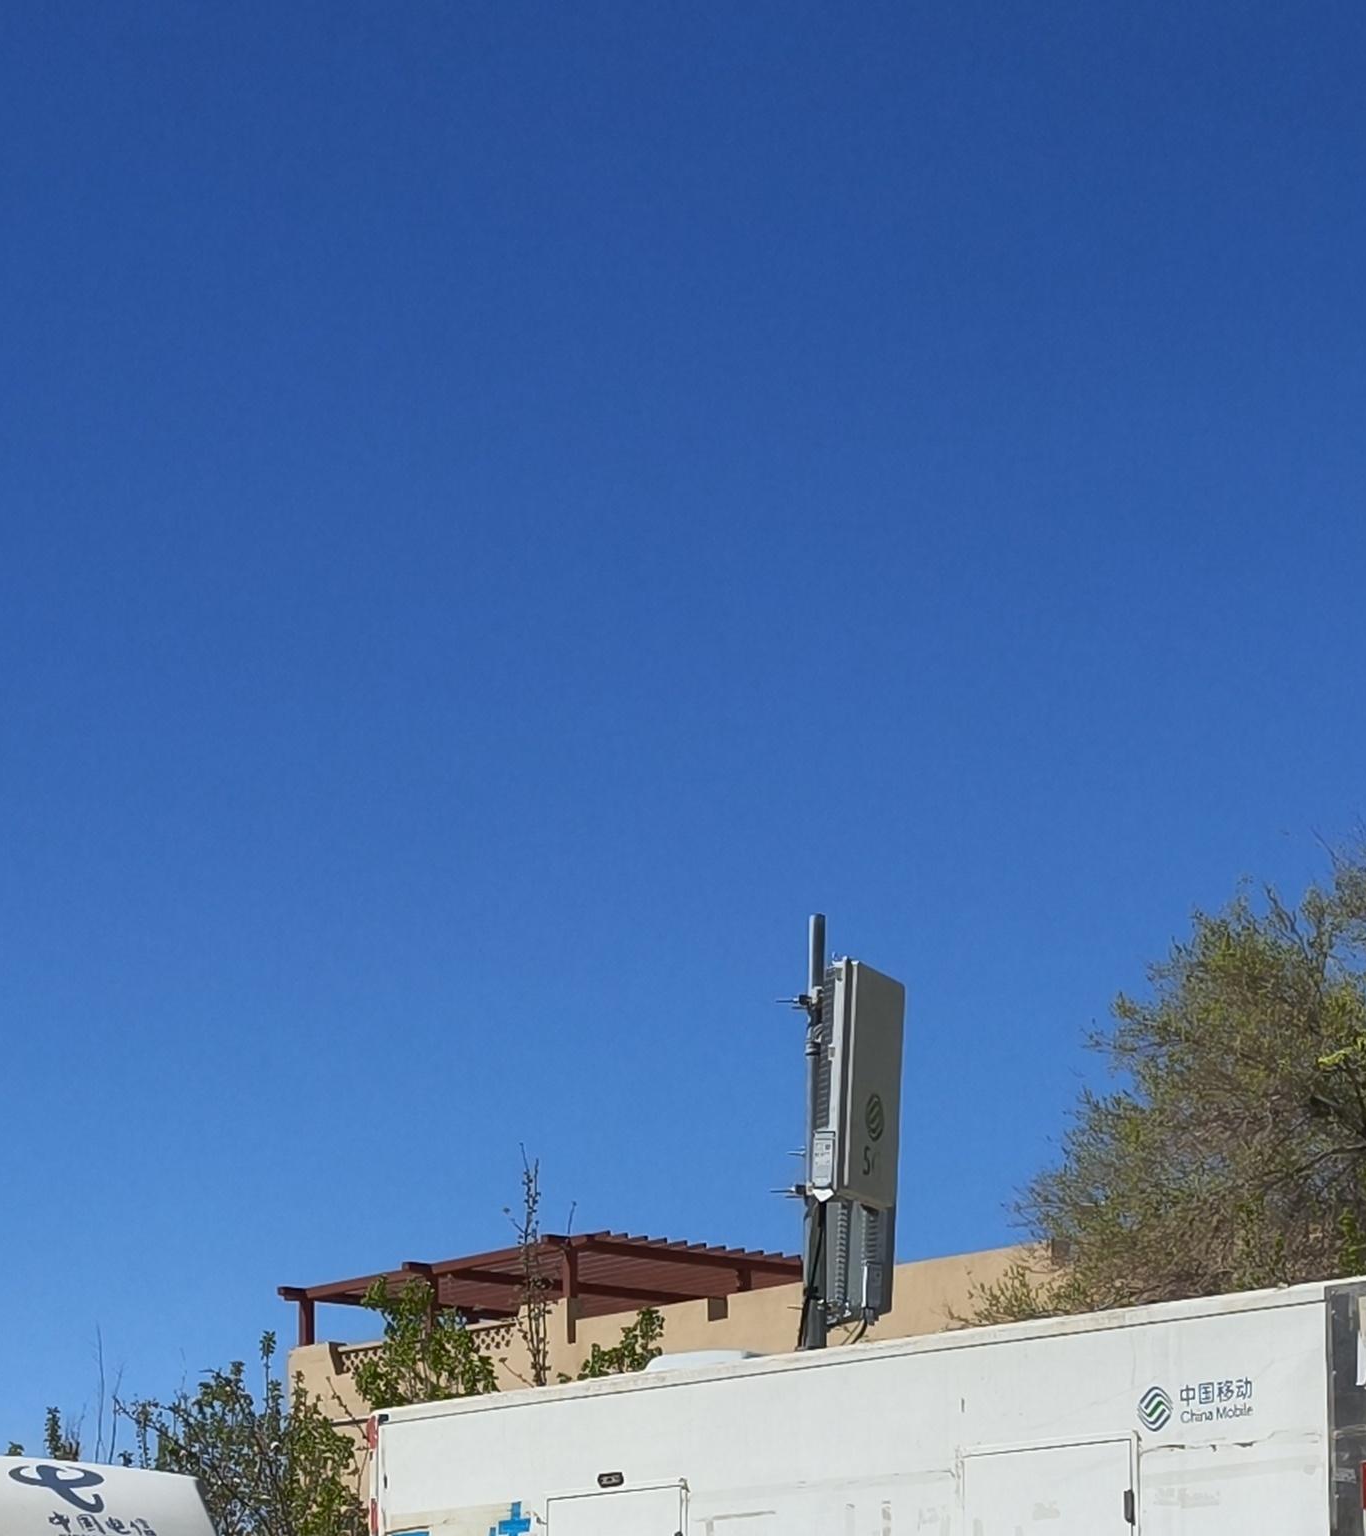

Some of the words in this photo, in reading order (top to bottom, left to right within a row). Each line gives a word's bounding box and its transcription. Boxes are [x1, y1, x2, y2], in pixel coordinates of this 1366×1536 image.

[1180, 1377, 1253, 1407] 中国移动
[1180, 1408, 1214, 1424] China
[1216, 1402, 1254, 1420] Mobile
[48, 1511, 157, 1536] 中国电信
